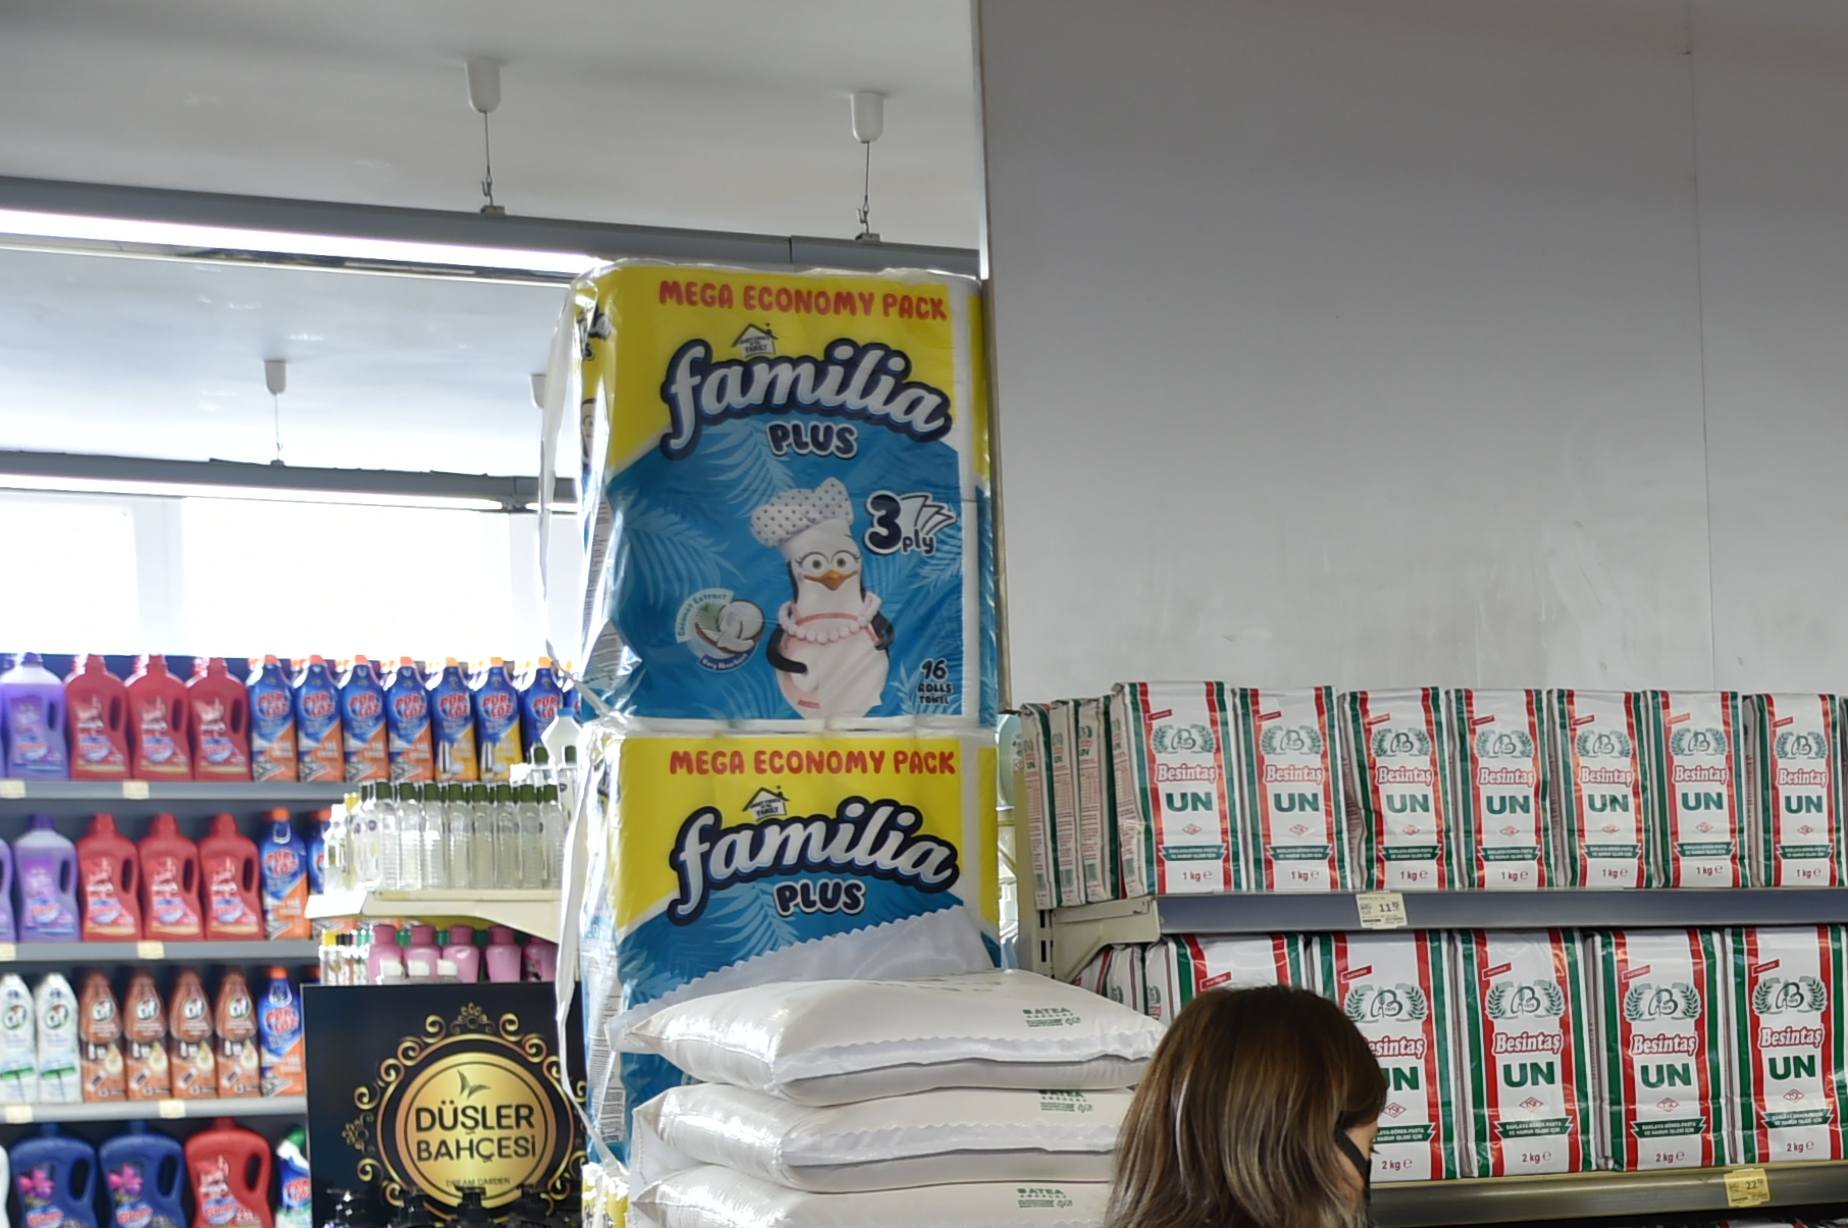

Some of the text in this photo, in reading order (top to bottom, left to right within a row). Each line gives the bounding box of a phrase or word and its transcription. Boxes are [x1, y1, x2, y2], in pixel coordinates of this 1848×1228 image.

[659, 279, 948, 321] MEGA ECONOMY PACK
[662, 340, 952, 459] familia
[769, 423, 858, 457] PLUS
[866, 492, 901, 554] 3
[902, 535, 936, 554] ply
[920, 659, 947, 679] 16
[918, 682, 952, 694] ROLLS
[669, 750, 955, 775] MEGA ECONOMY PACK
[1156, 763, 1217, 783] Besintaş
[1265, 764, 1323, 784] Besintaş
[1672, 765, 1728, 785] Besintaş
[1165, 792, 1213, 812] UN
[1273, 793, 1320, 812] UN
[1681, 792, 1724, 812] UN
[669, 797, 959, 925] familia
[775, 880, 865, 916] PLUS
[1630, 1033, 1698, 1056] Besintaş
[1640, 1064, 1692, 1089] UN
[415, 1100, 535, 1134] DÜŞLER
[416, 1134, 536, 1163] BAHÇESİ
[1655, 1151, 1675, 1164] 2 kg
